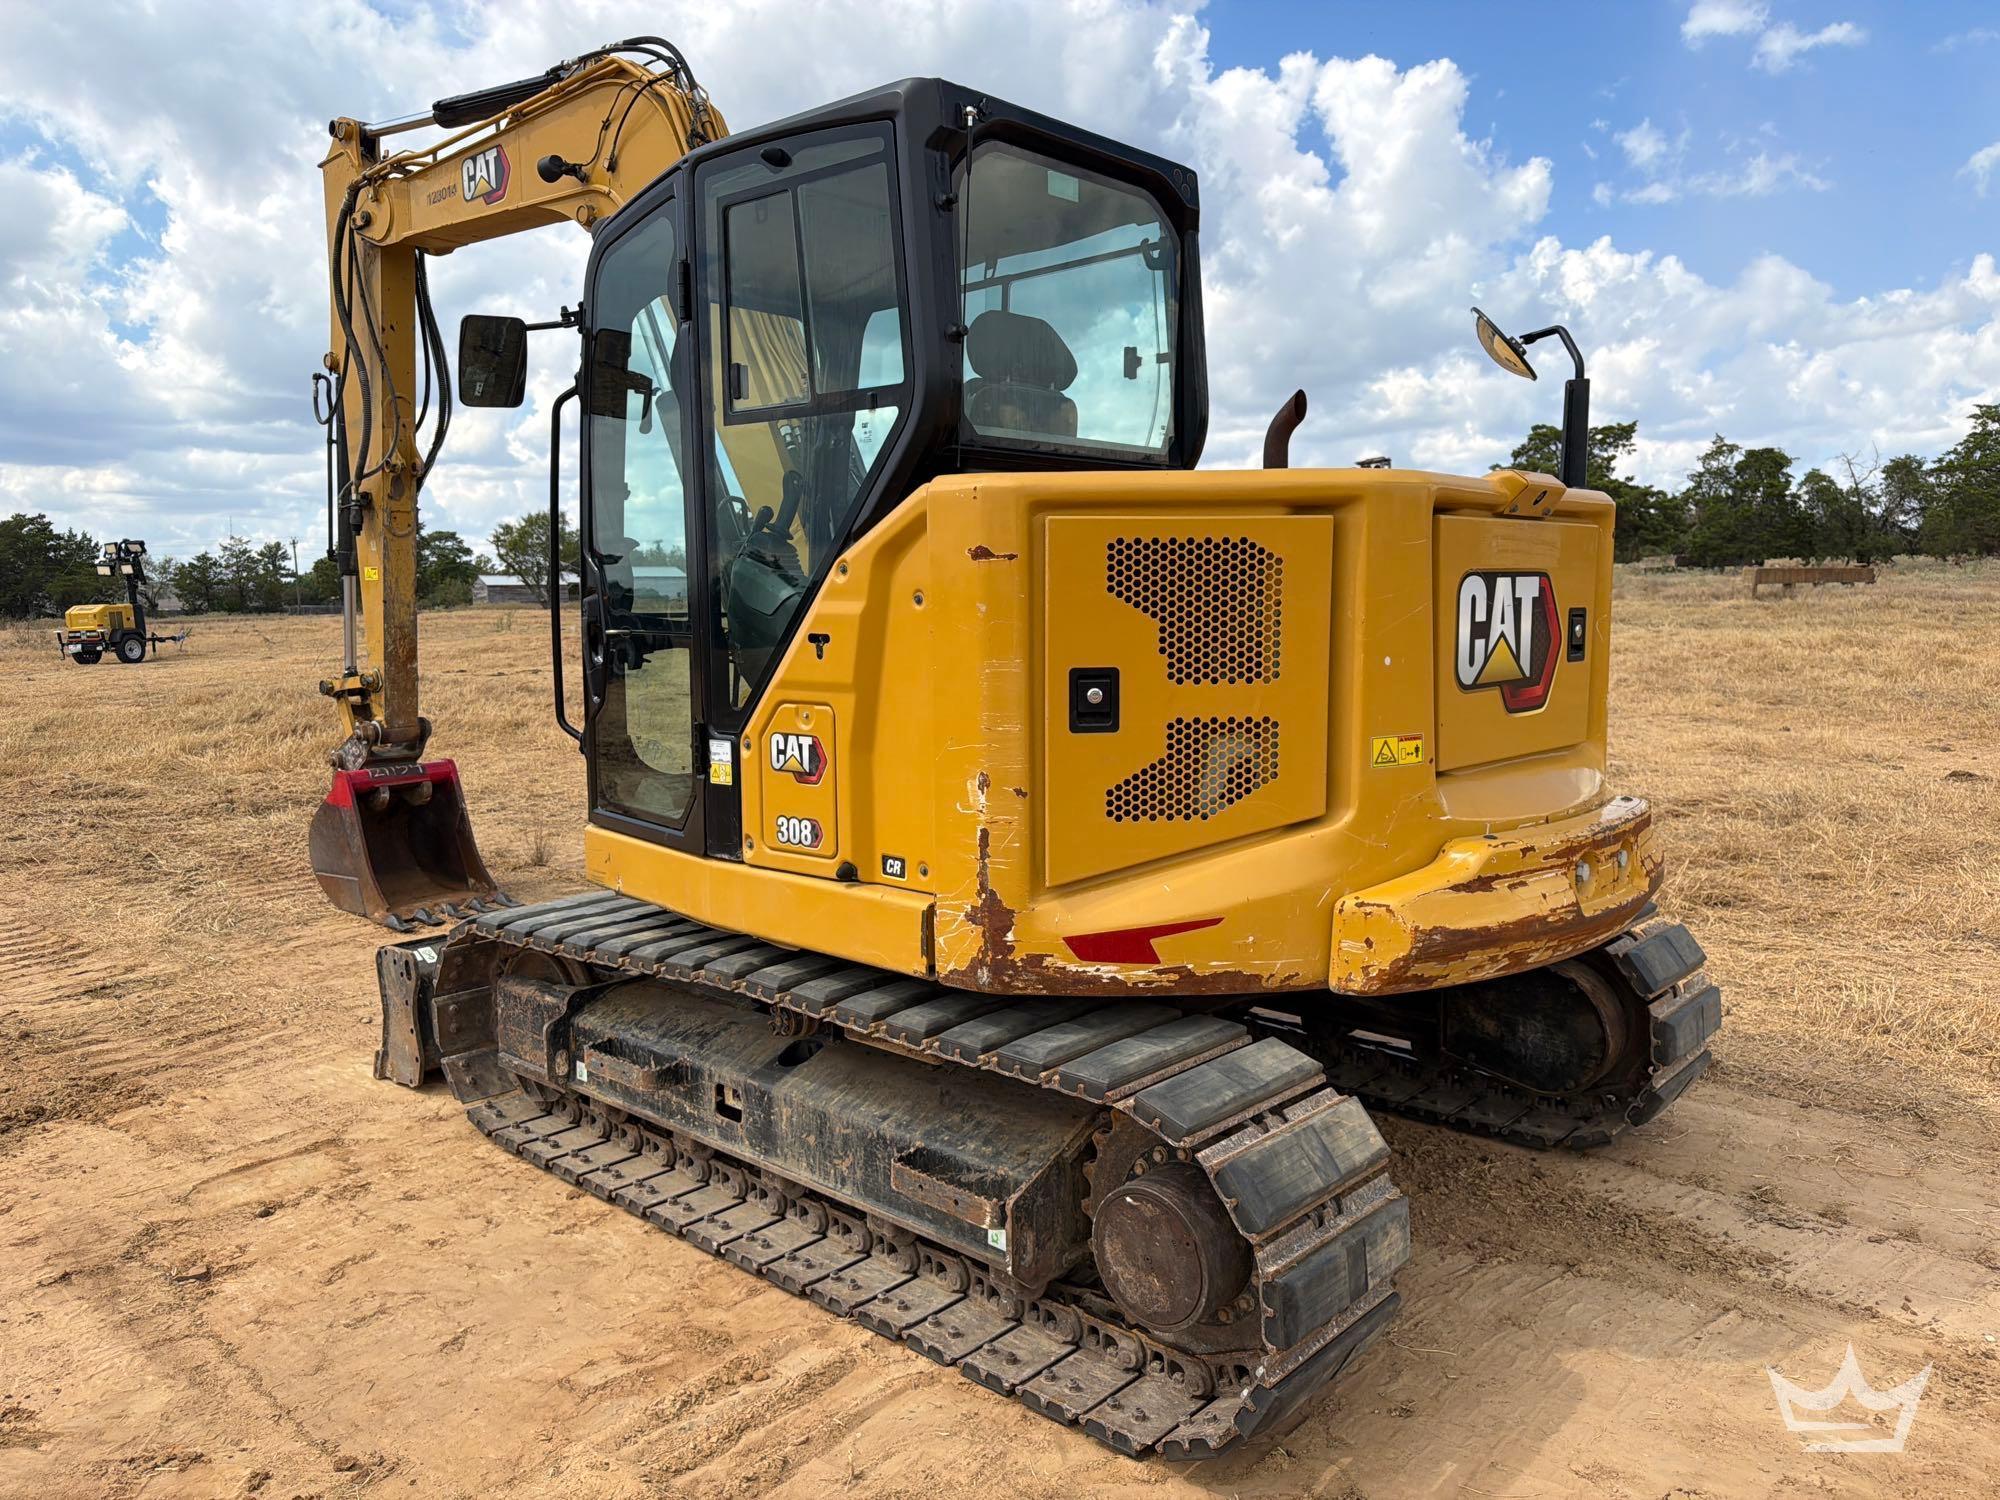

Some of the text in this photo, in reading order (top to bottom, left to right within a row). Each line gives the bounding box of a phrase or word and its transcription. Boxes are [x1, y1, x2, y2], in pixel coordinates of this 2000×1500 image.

[462, 147, 498, 200] CAT
[1457, 574, 1540, 686] CAT
[771, 733, 813, 773] CAT
[777, 816, 812, 846] 308
[885, 858, 902, 875] CR
